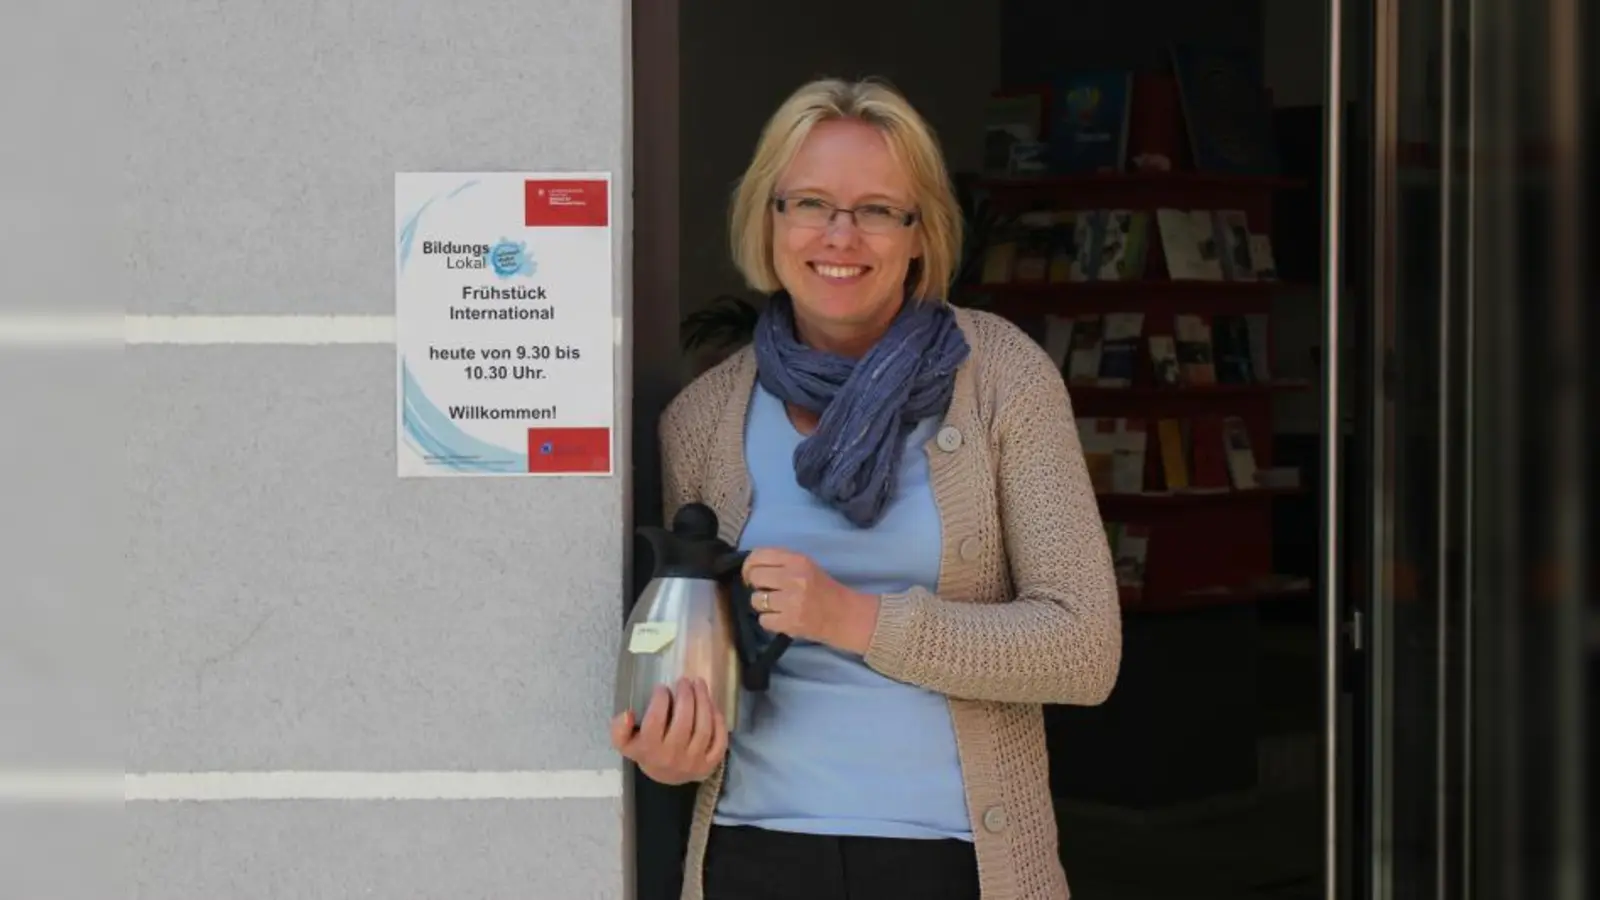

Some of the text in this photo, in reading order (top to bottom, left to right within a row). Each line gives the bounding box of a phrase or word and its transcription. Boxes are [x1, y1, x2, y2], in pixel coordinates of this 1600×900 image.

[423, 241, 489, 257] Bildungs
[447, 256, 486, 269] Lokal
[462, 285, 547, 300] Frühstück
[450, 305, 555, 320] International
[430, 345, 580, 360] heute von 9.30 bis
[465, 366, 547, 380] 10.30 Uhr.
[449, 405, 557, 420] Willkommen!
